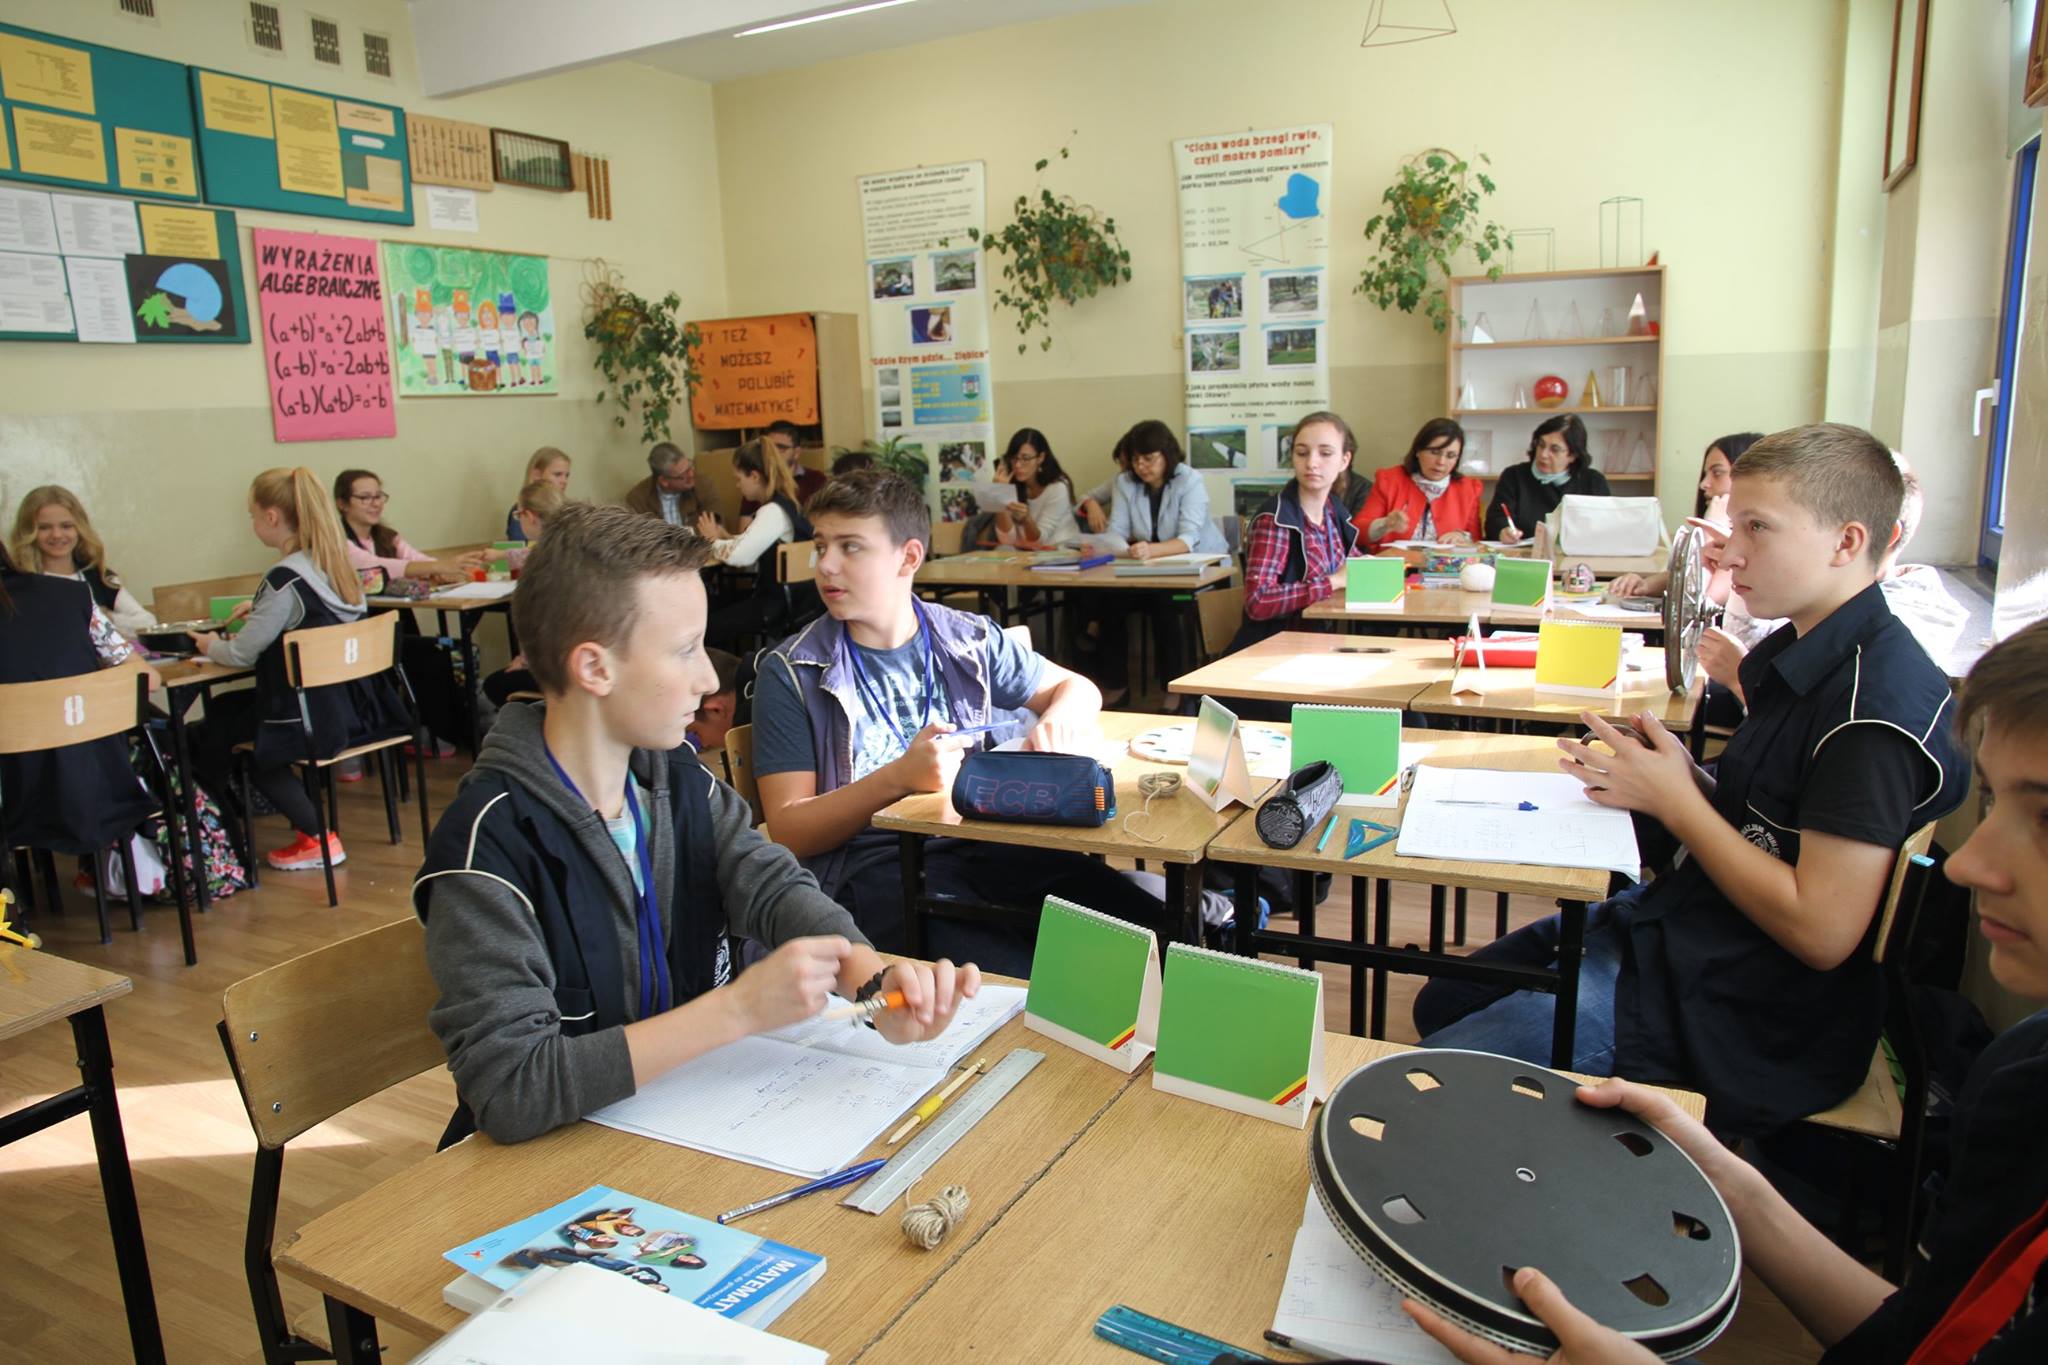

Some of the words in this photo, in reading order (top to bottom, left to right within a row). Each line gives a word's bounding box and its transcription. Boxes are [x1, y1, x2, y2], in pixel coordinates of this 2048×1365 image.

[1221, 138, 1250, 150] woda
[1253, 131, 1289, 146] brzegi
[1193, 153, 1220, 166] czyli
[1222, 150, 1257, 163] mokre
[262, 245, 374, 275] WYRAŻENIA
[260, 272, 381, 301] ALGEBRAICZNE
[720, 348, 773, 368] MOŻESZ
